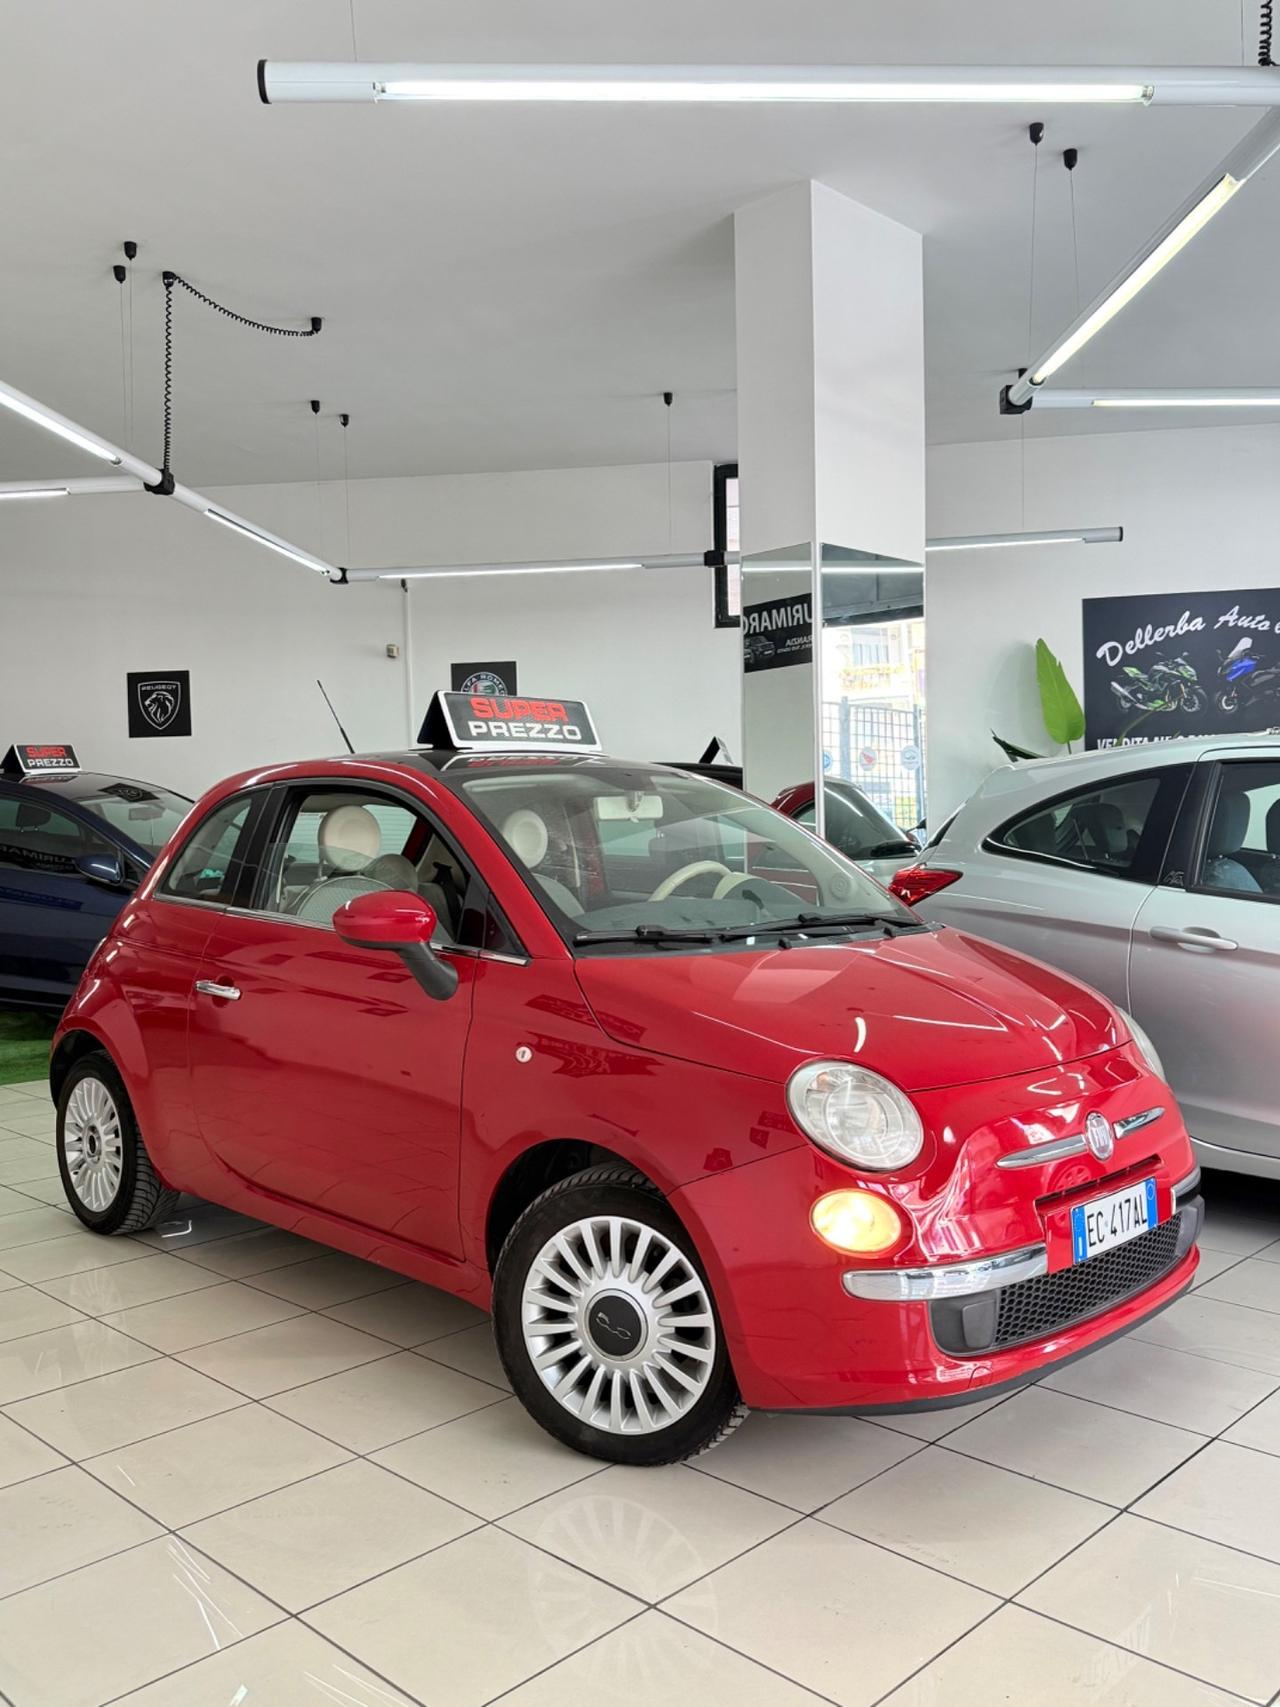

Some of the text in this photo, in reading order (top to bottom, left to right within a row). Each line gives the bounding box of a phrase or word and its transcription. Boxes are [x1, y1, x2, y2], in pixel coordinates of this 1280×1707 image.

[1096, 610, 1206, 666] Dellerba
[1214, 605, 1270, 630] Auto
[470, 698, 568, 721] SUPER
[468, 721, 581, 740] PREZZO
[26, 746, 67, 758] SUPER
[27, 758, 73, 767] PREZZO
[1087, 1211, 1105, 1247] EC
